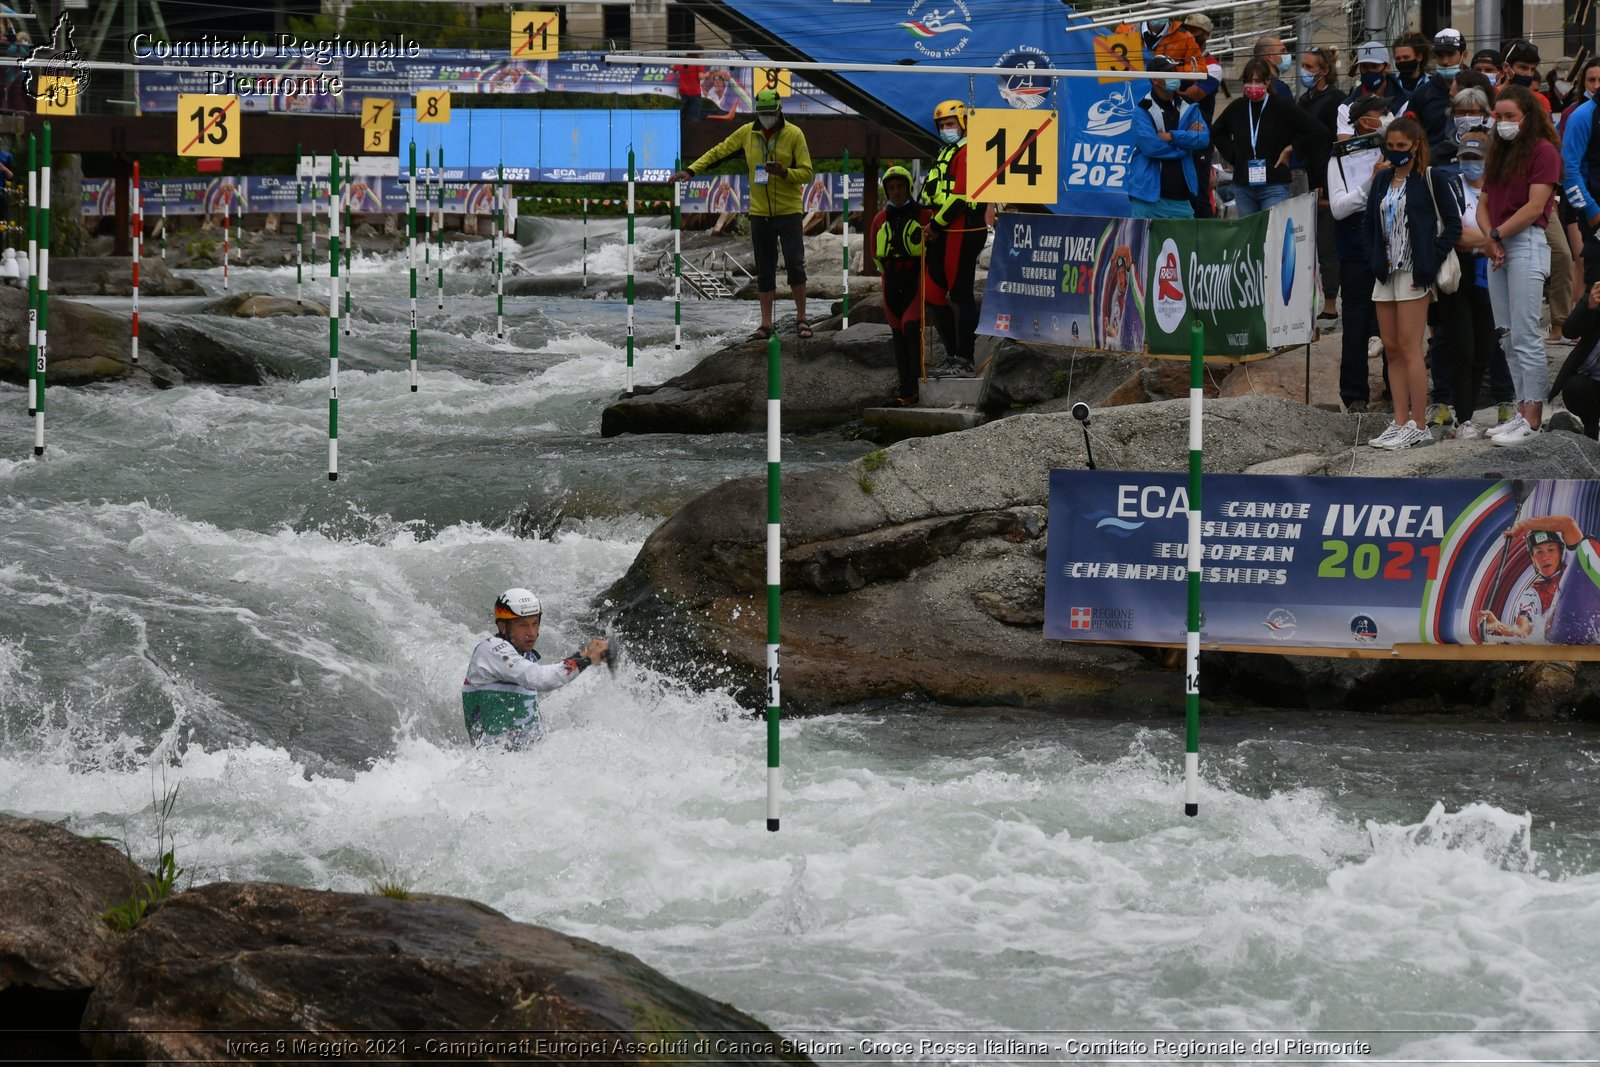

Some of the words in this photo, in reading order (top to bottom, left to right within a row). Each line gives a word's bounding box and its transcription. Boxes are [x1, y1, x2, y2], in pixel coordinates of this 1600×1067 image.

[523, 21, 547, 50] 11
[914, 41, 942, 58] Canoa
[943, 36, 969, 57] Kayak
[1110, 43, 1130, 71] 3
[367, 60, 396, 72] ECA
[572, 63, 599, 71] ECA
[766, 68, 778, 90] 9
[372, 105, 384, 124] 7
[427, 96, 438, 117] 8
[190, 106, 228, 144] 13
[373, 131, 381, 146] 5
[986, 128, 1042, 186] 14
[1014, 223, 1033, 249] ECA
[1038, 235, 1062, 249] CANOE
[1064, 236, 1096, 262] IVREA
[1189, 249, 1235, 326] Raspini
[1117, 484, 1189, 519] ECA
[1222, 501, 1311, 519] CANOE
[1202, 520, 1302, 539] SLALOM
[1322, 504, 1445, 539] IVREA
[1317, 539, 1441, 581] 2021
[1068, 562, 1287, 585] CHAMPIOSHIPS
[1091, 608, 1135, 619] REGIONE
[1091, 619, 1133, 630] PIEMONTE
